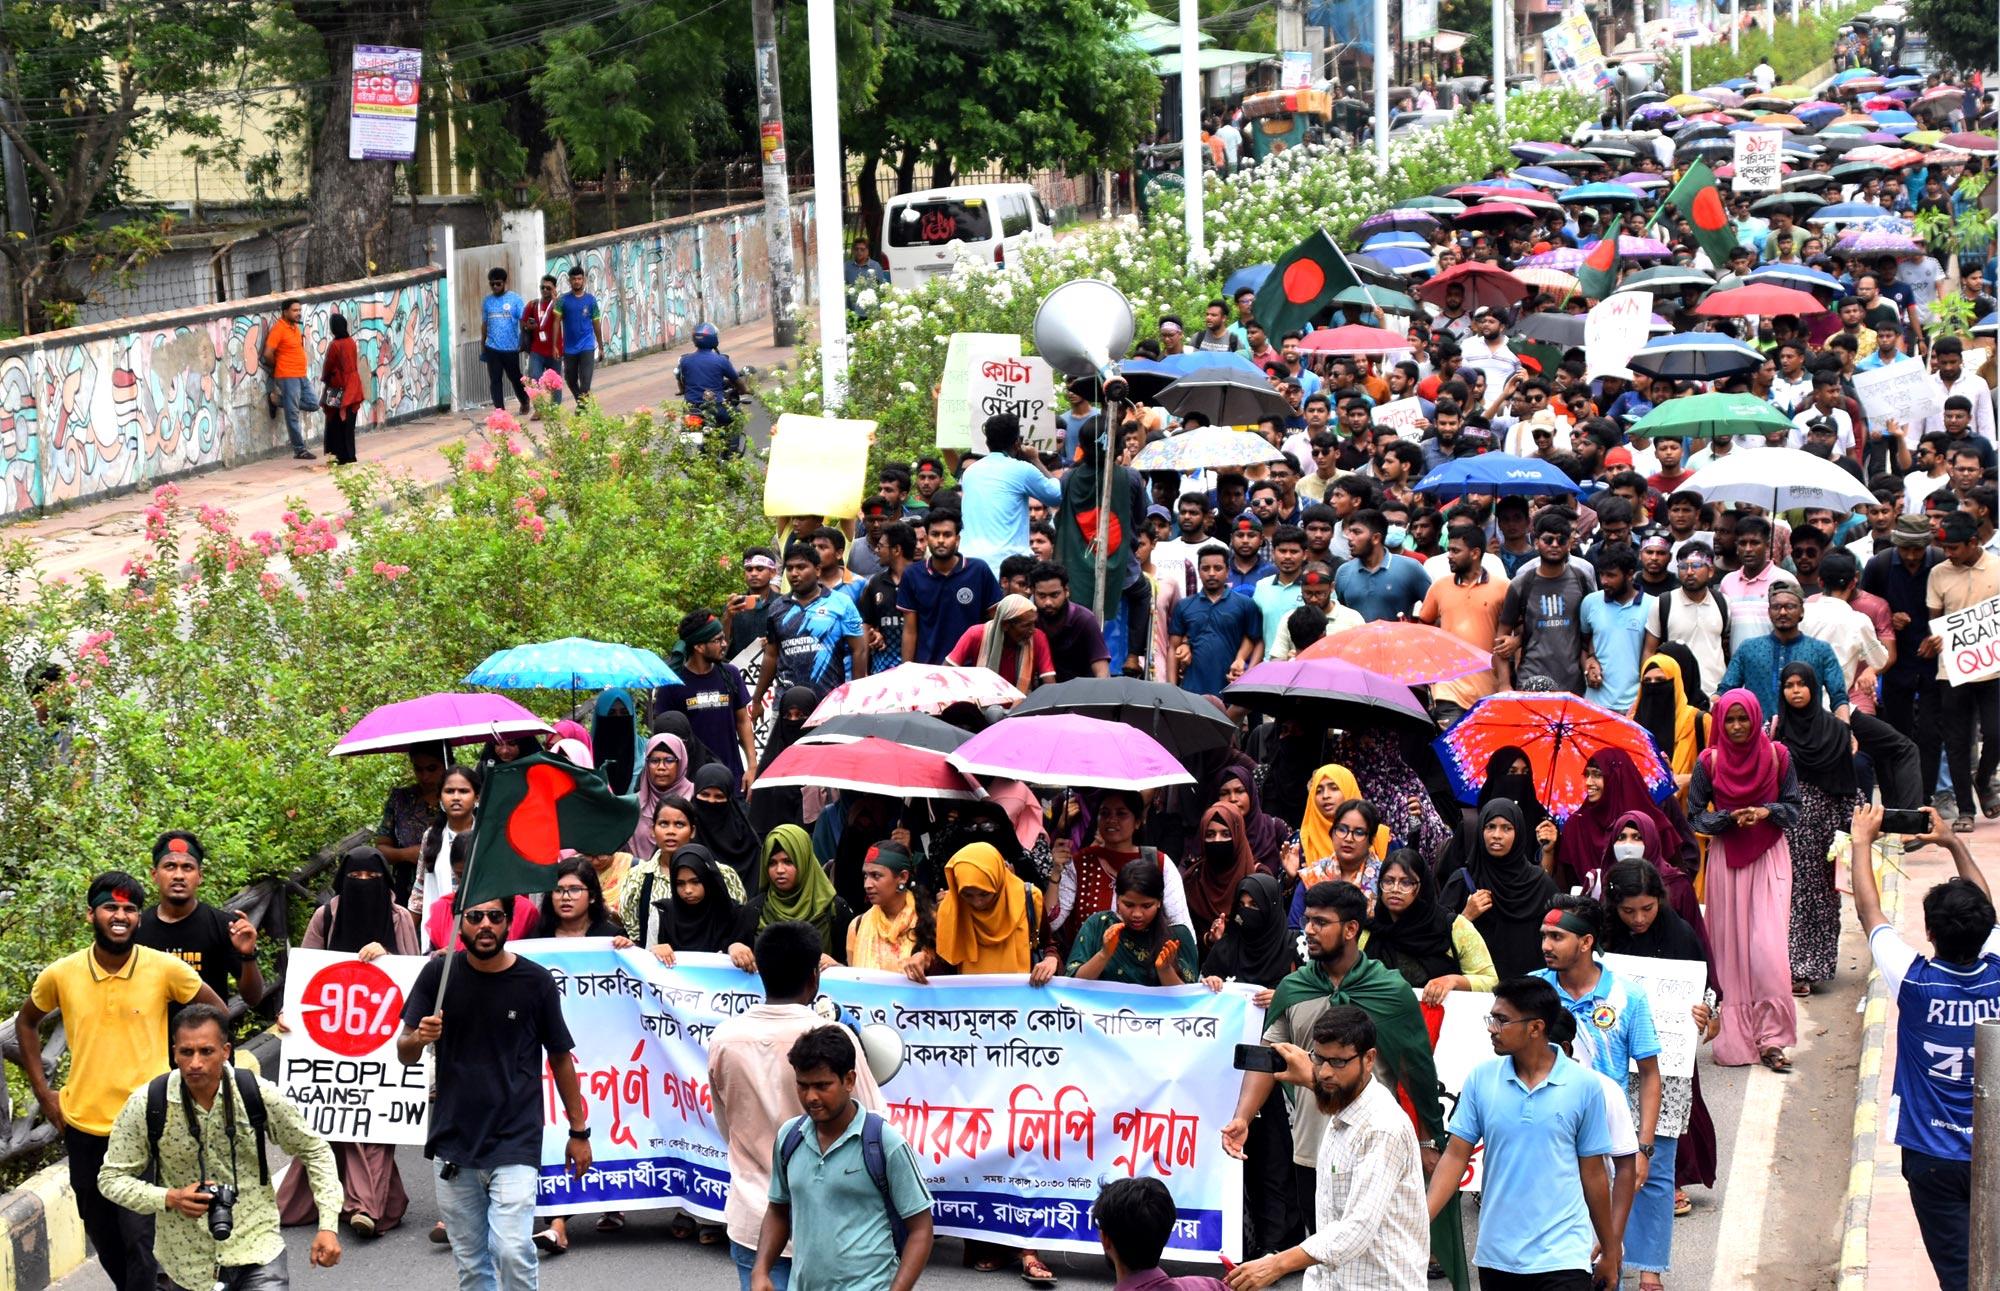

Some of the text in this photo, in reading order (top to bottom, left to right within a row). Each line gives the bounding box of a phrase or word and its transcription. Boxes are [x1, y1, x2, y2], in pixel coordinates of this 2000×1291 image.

[357, 75, 393, 91] BCS
[982, 357, 1032, 384] কোটা
[996, 383, 1016, 398] না
[982, 396, 1044, 421] মেধা?
[1537, 619, 1571, 627] FREEDOM
[574, 967, 643, 1000] চাকরির
[648, 982, 704, 1010] সকল
[320, 982, 398, 1036] 96%
[893, 1002, 1018, 1039] বৈষম্যমূলক
[1027, 1003, 1085, 1033] কোটা
[1093, 1008, 1164, 1036] বাতিল
[1171, 1016, 1220, 1039] করে
[640, 1011, 682, 1040] কোটা
[985, 1037, 1064, 1068] দাবিতে
[1923, 1041, 1976, 1084] 3
[287, 1058, 426, 1088] PEOPLE
[285, 1085, 375, 1105] AGAINST
[303, 1106, 371, 1137] UOTA
[1007, 1083, 1096, 1161] লিপি
[1112, 1106, 1199, 1177] প্রদান
[580, 1161, 690, 1195] শিক্ষার্থীবৃন্দ,
[1008, 1177, 1031, 1188] সকাল
[1034, 1178, 1064, 1189] ১০:৩০
[1068, 1177, 1092, 1189] মিনিট
[992, 1201, 1081, 1232] রাজশাহী
